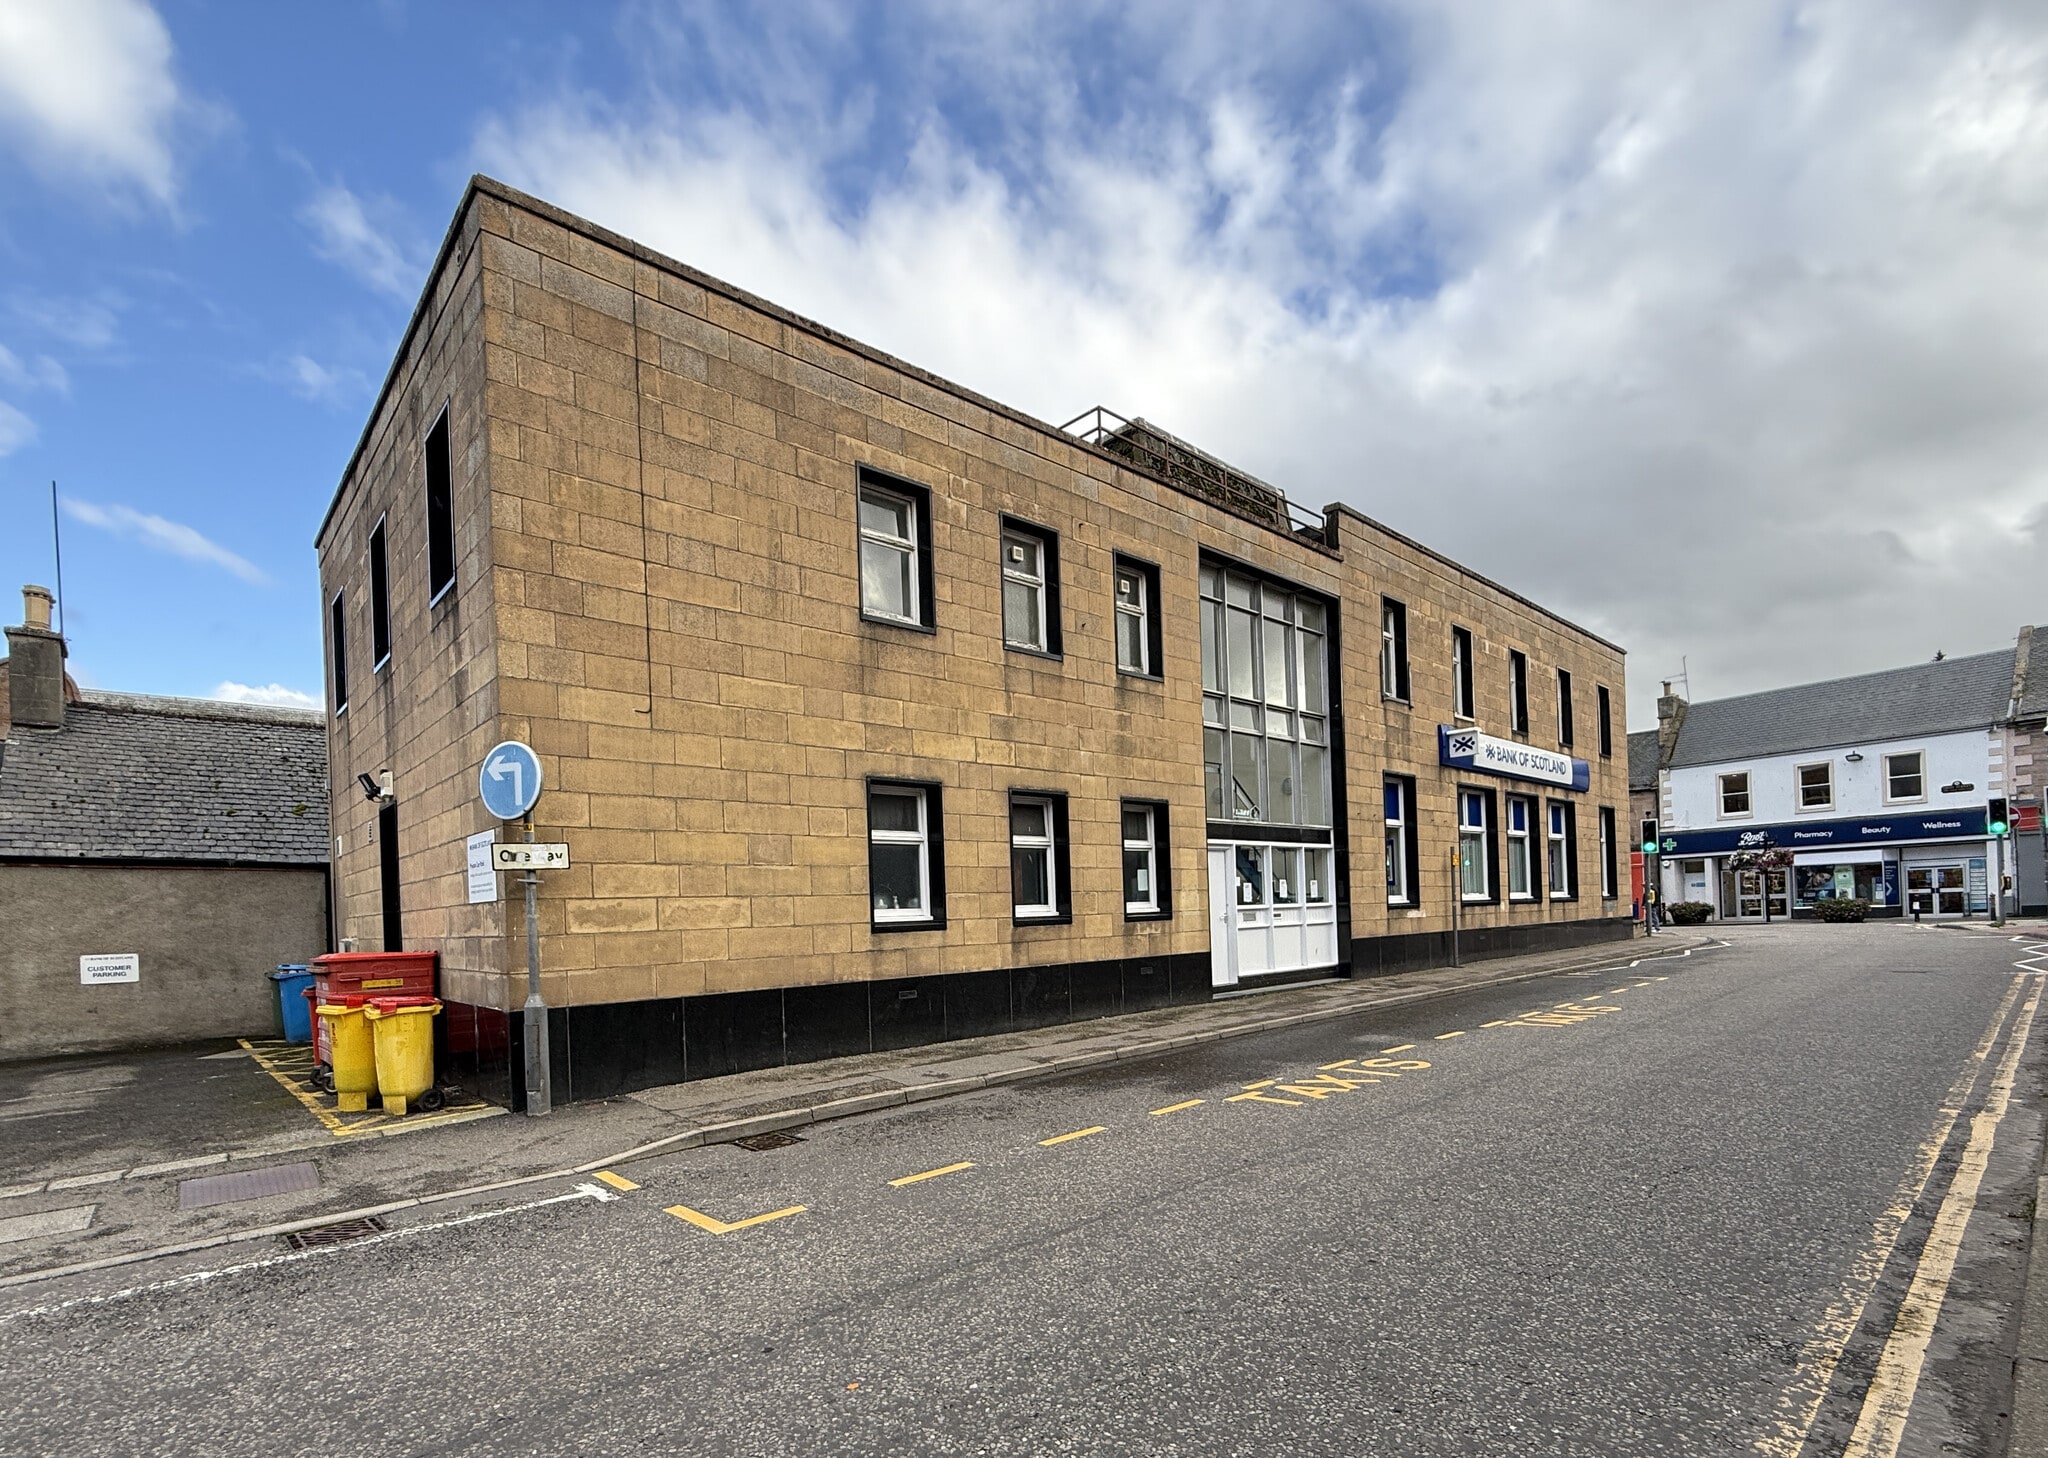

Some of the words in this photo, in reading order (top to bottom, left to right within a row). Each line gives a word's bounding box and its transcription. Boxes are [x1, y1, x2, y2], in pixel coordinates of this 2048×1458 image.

[1497, 746, 1518, 765] BANK
[1519, 751, 1530, 767] OF
[1530, 754, 1567, 775] SCOTLAND
[1922, 821, 1961, 829] Wellness
[1861, 826, 1891, 834] Beauty
[1794, 831, 1833, 839] Pharmacy
[1224, 1057, 1431, 1106] TAXIS
